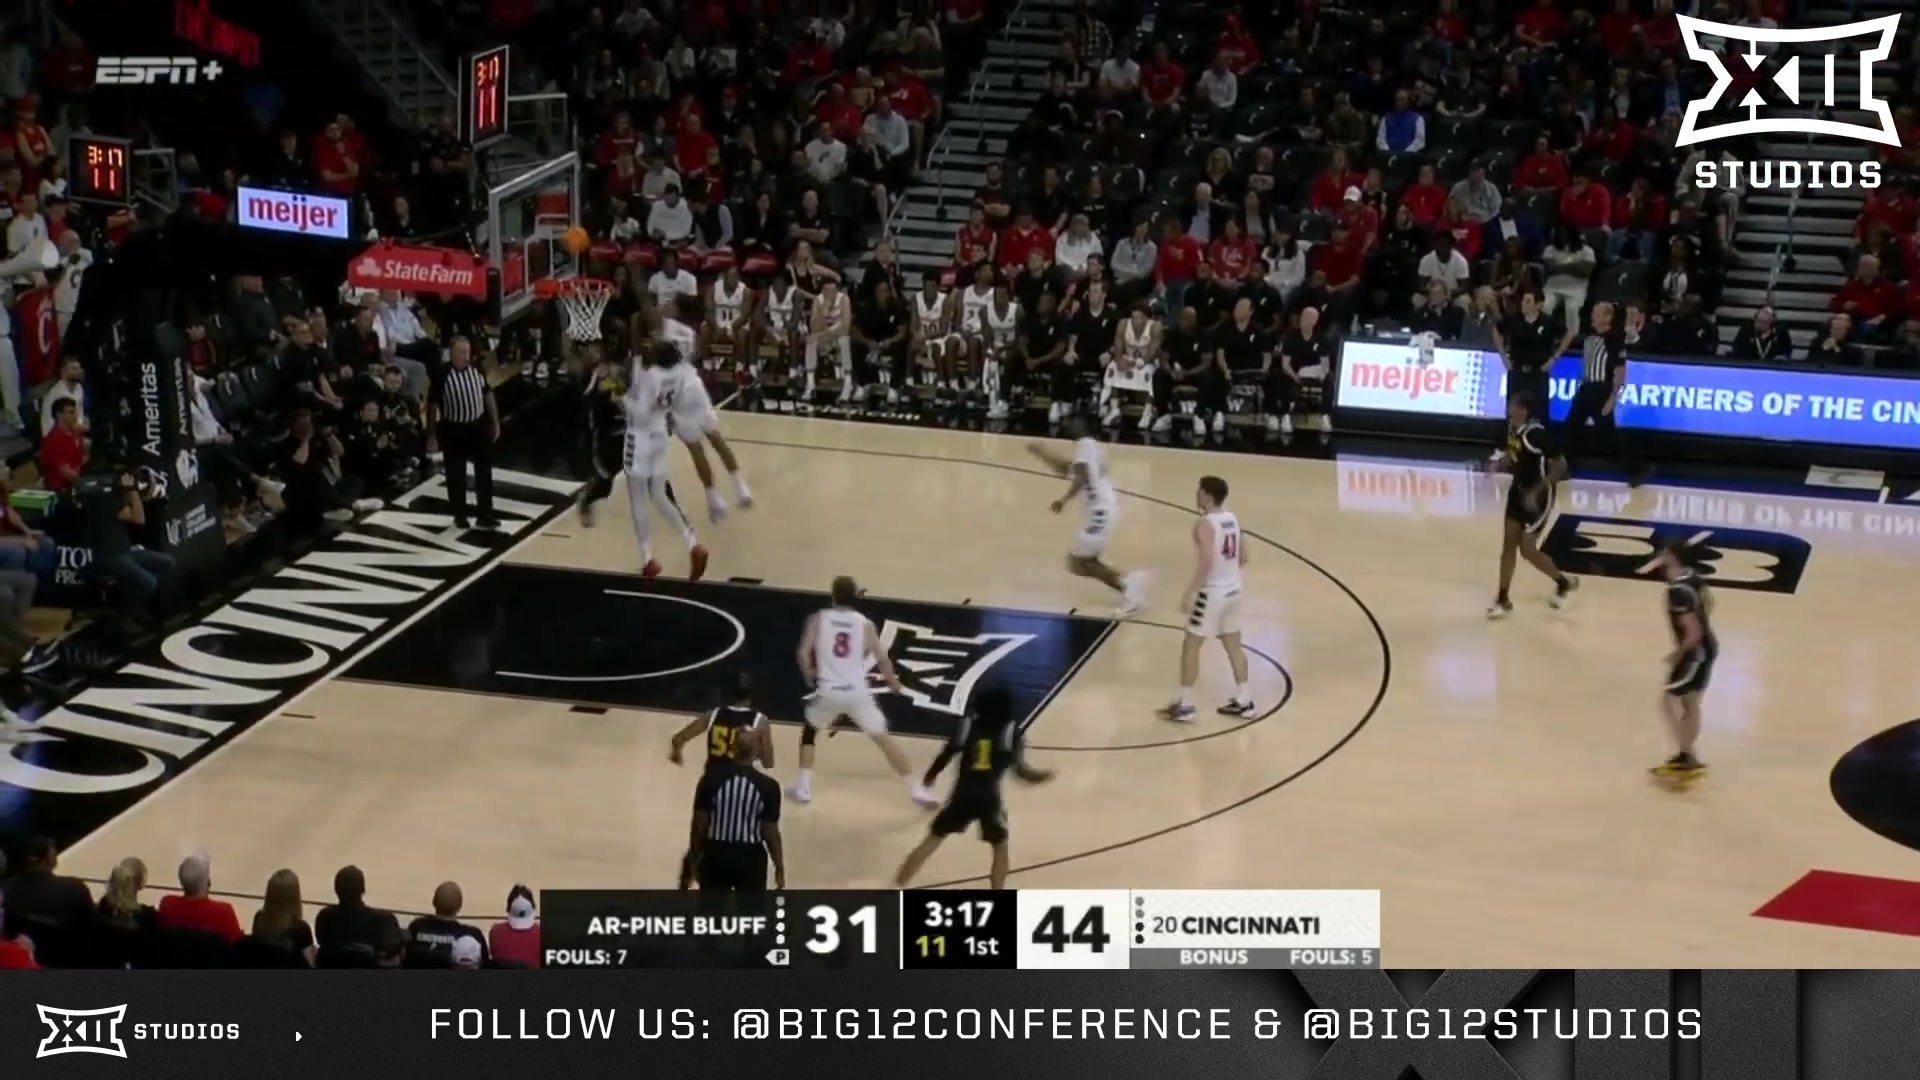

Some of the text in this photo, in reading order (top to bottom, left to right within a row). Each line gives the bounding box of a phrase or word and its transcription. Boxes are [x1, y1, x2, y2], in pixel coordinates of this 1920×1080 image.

[87, 145, 123, 168] 3:17
[94, 167, 115, 191] 11
[248, 195, 338, 231] meijer
[1350, 356, 1459, 399] meijer
[141, 362, 161, 456] Ameritas
[1619, 383, 1753, 413] ARTNERS
[1762, 392, 1802, 417] OF
[1808, 396, 1864, 421] THE
[832, 631, 851, 659] 8
[973, 738, 992, 770] 1
